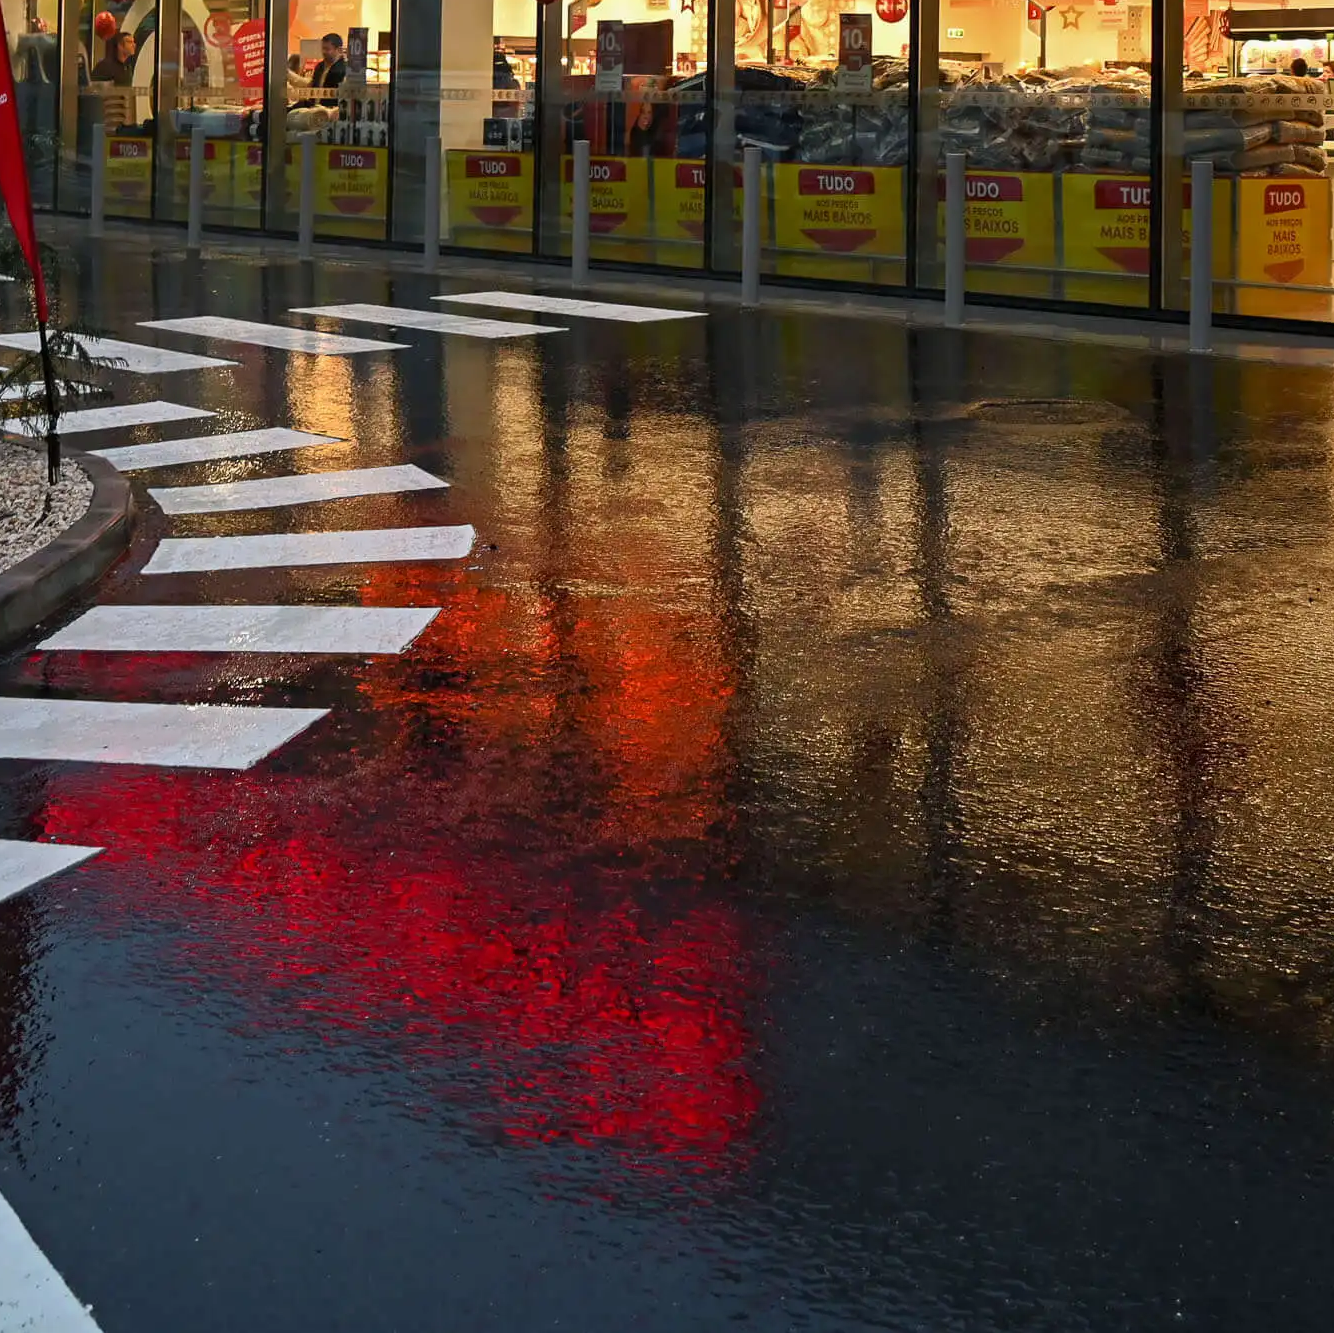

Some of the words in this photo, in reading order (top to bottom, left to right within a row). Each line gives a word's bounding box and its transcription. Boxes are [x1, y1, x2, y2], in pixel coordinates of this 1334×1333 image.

[340, 154, 364, 167] TUDO
[478, 160, 507, 175] TUDO
[589, 165, 610, 180] UDO
[691, 169, 706, 184] TU
[817, 175, 855, 191] TUDO
[967, 180, 999, 198] UDO
[1120, 187, 1151, 205] TUD
[1269, 191, 1301, 206] TUDO
[803, 209, 830, 222] MAIS
[974, 218, 1020, 234] BAIXOS
[1100, 226, 1135, 240] MAIS
[1273, 230, 1296, 243] MAIS
[1267, 244, 1301, 256] BAIXOS
